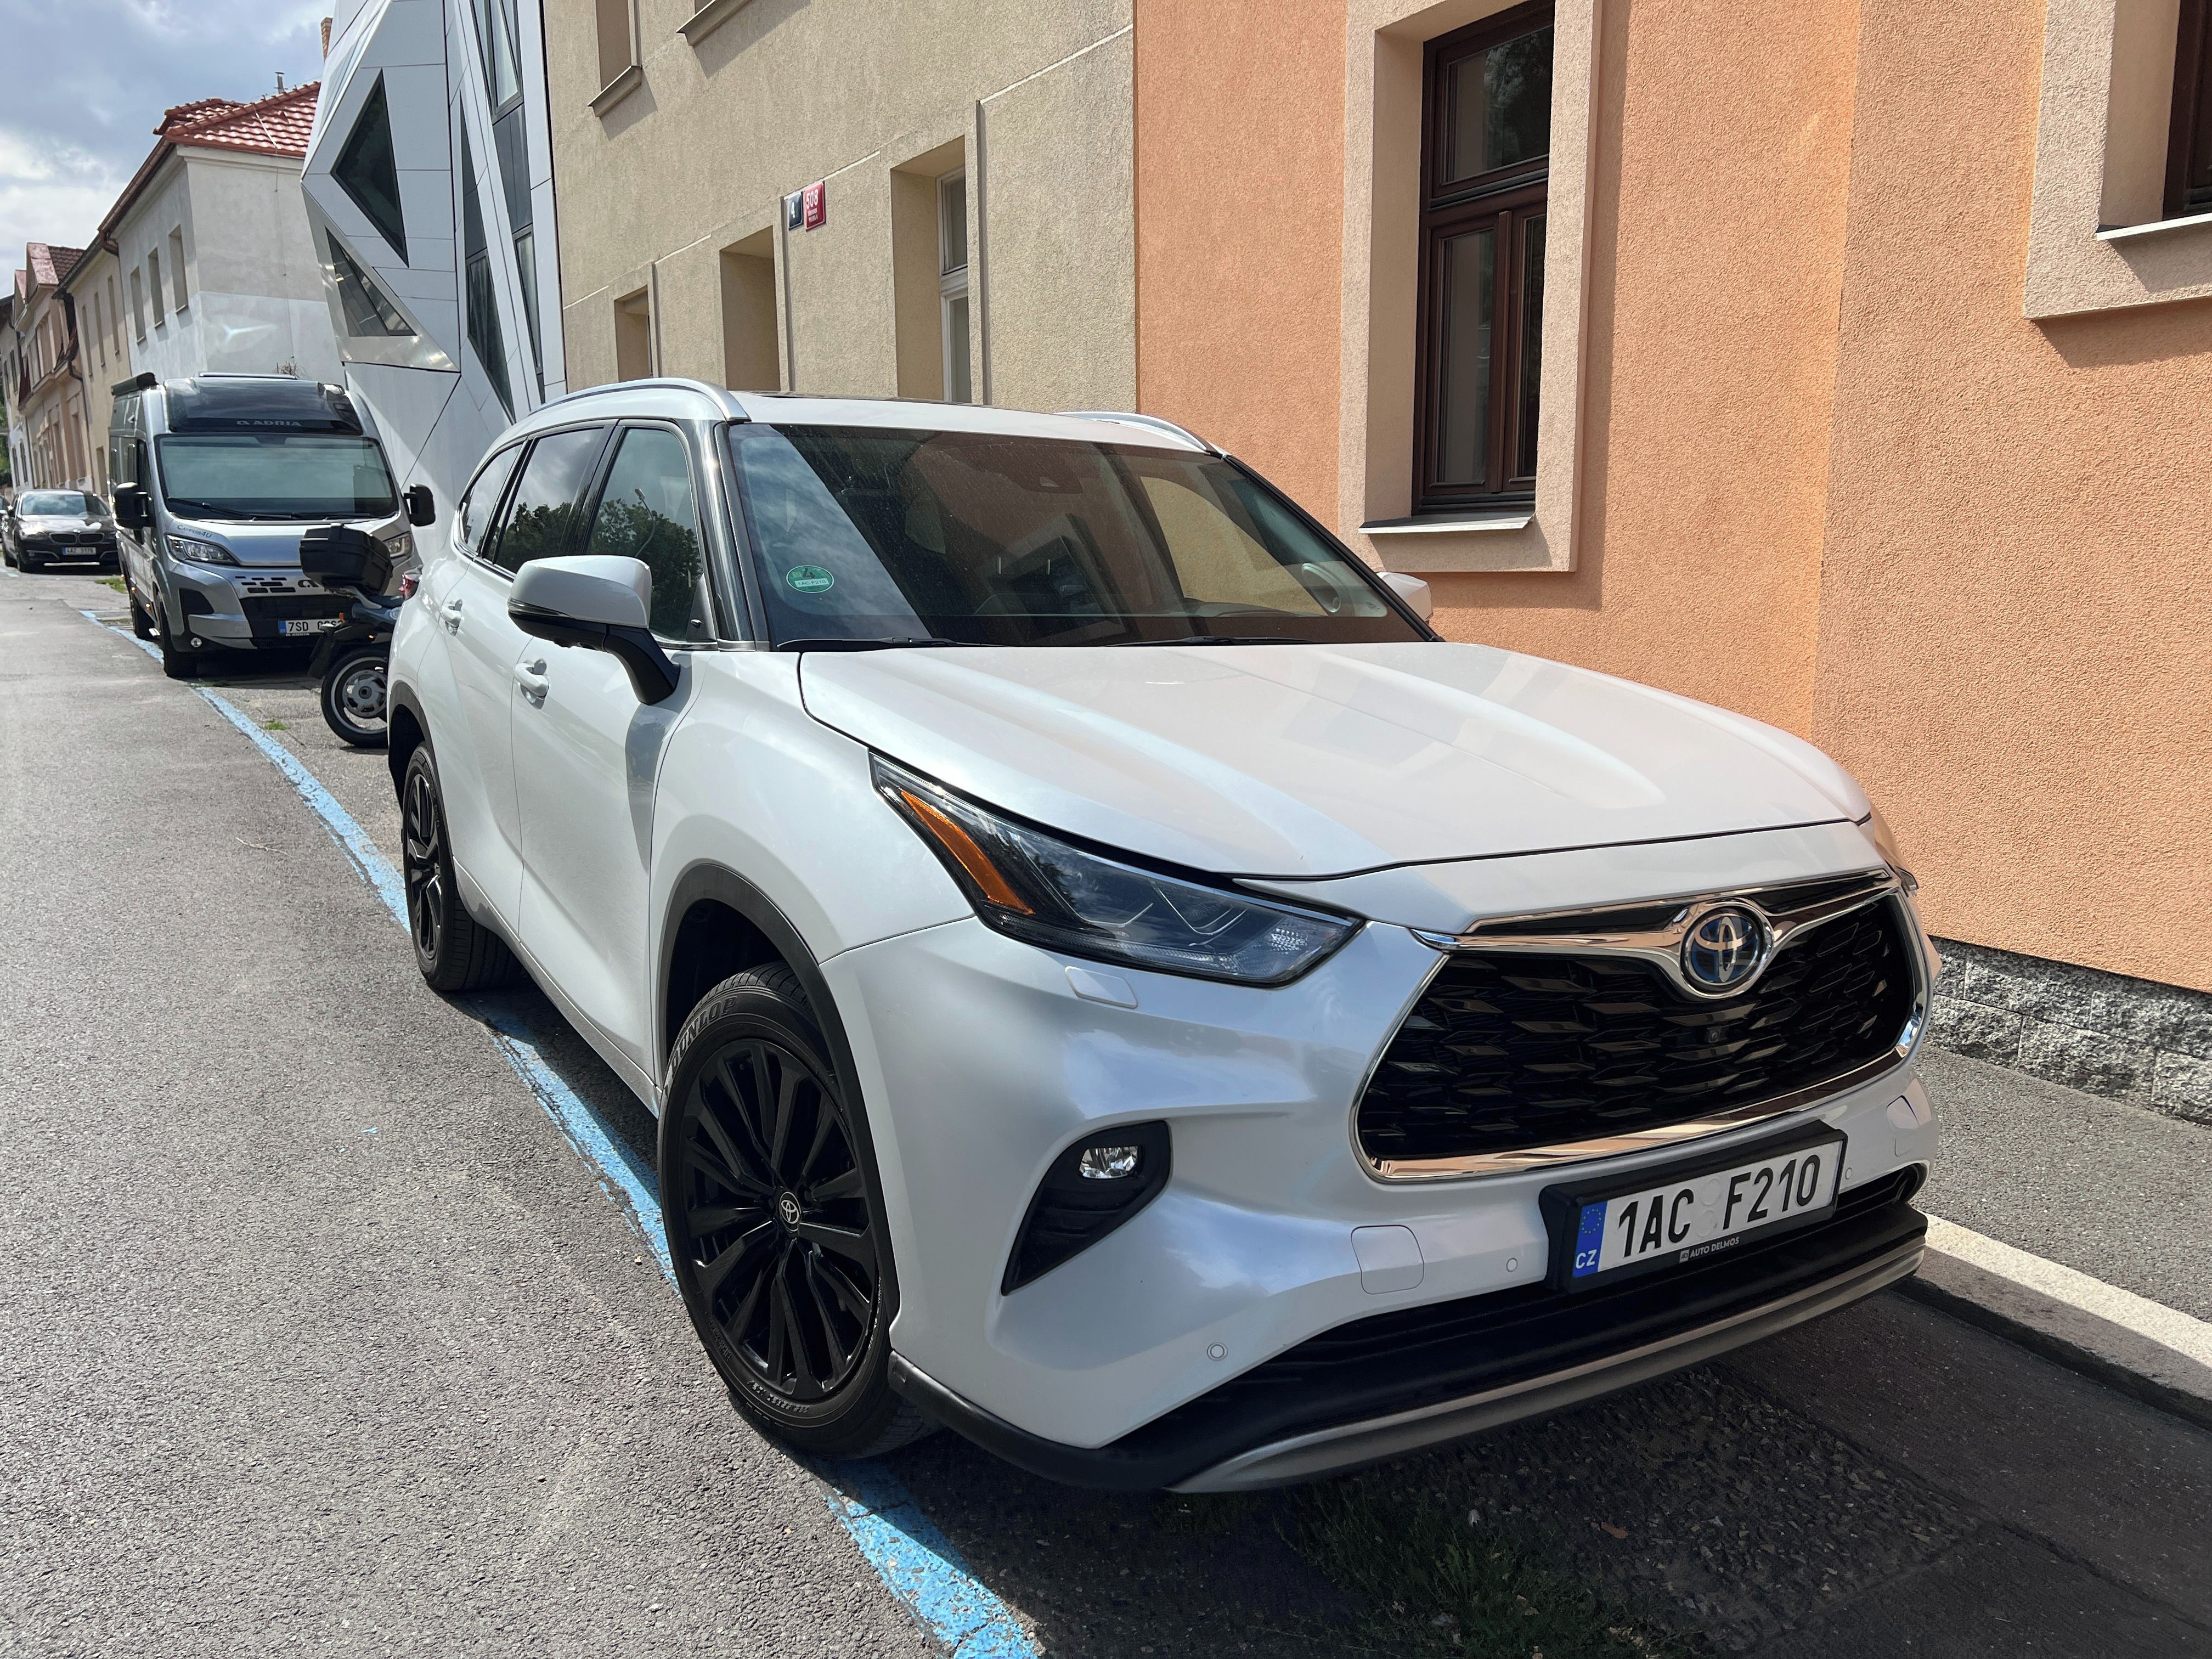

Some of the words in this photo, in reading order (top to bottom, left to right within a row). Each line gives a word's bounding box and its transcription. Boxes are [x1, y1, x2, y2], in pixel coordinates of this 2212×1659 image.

[791, 201, 795, 218] 4
[806, 189, 819, 210] 508
[288, 622, 309, 631] 7SD
[672, 996, 737, 1079] DUNLOP
[1618, 1189, 1694, 1258] 1AC
[1723, 1154, 1820, 1230] F210
[1690, 1245, 1710, 1258] AUTO
[1711, 1237, 1740, 1252] DELMOS
[1576, 1249, 1598, 1269] CZ
